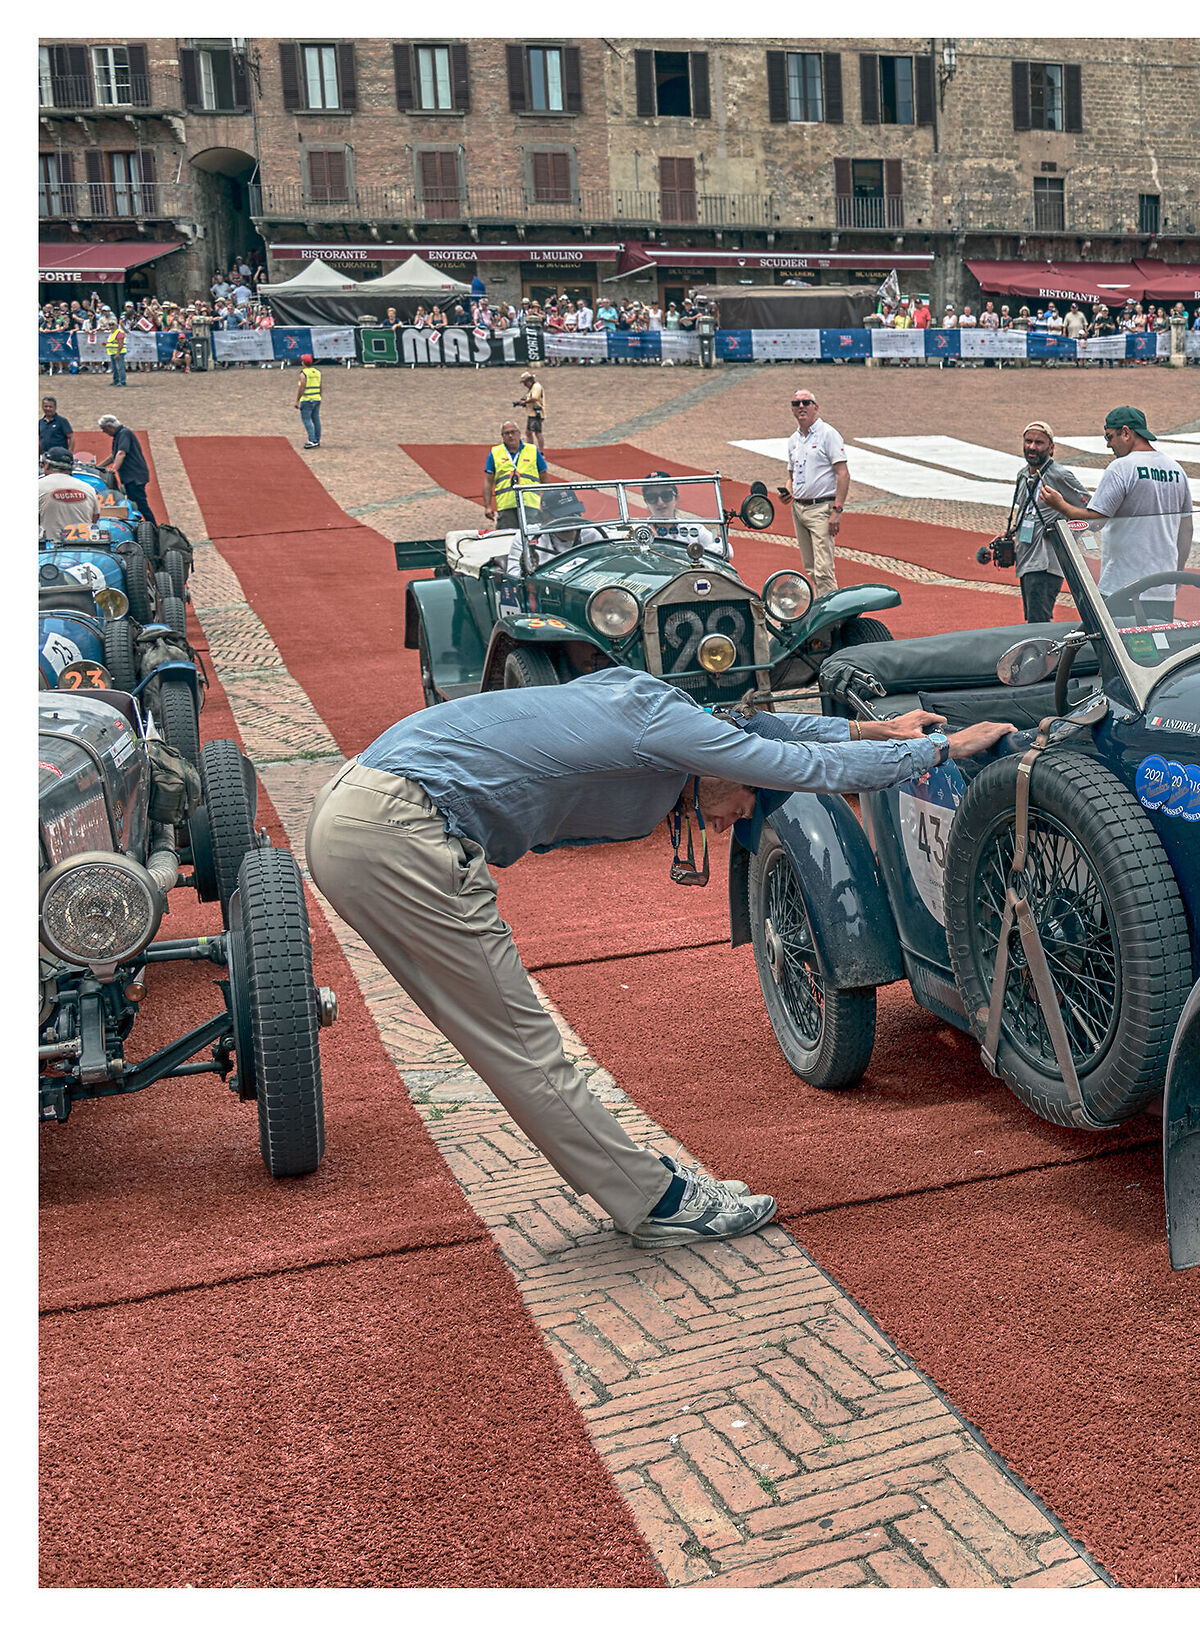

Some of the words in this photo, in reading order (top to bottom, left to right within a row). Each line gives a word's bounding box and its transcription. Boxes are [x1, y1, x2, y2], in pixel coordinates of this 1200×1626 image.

[301, 250, 368, 259] RISTORANTE
[428, 251, 478, 260] ENOTECA
[530, 251, 540, 260] IL
[542, 251, 583, 260] MULINO
[760, 258, 808, 268] SCUDIERI
[39, 272, 82, 281] FORTE
[1039, 288, 1100, 303] RISTORANTE
[402, 328, 521, 363] MAST
[1150, 467, 1180, 483] MAST
[54, 492, 85, 500] BUGATTI
[96, 493, 116, 507] 24
[63, 523, 91, 540] 25
[52, 640, 74, 666] 23
[65, 670, 106, 690] 23
[1162, 718, 1197, 733] ANDREA
[1144, 767, 1165, 783] 2021
[1140, 795, 1163, 810] PASSED
[918, 811, 945, 869] 43
